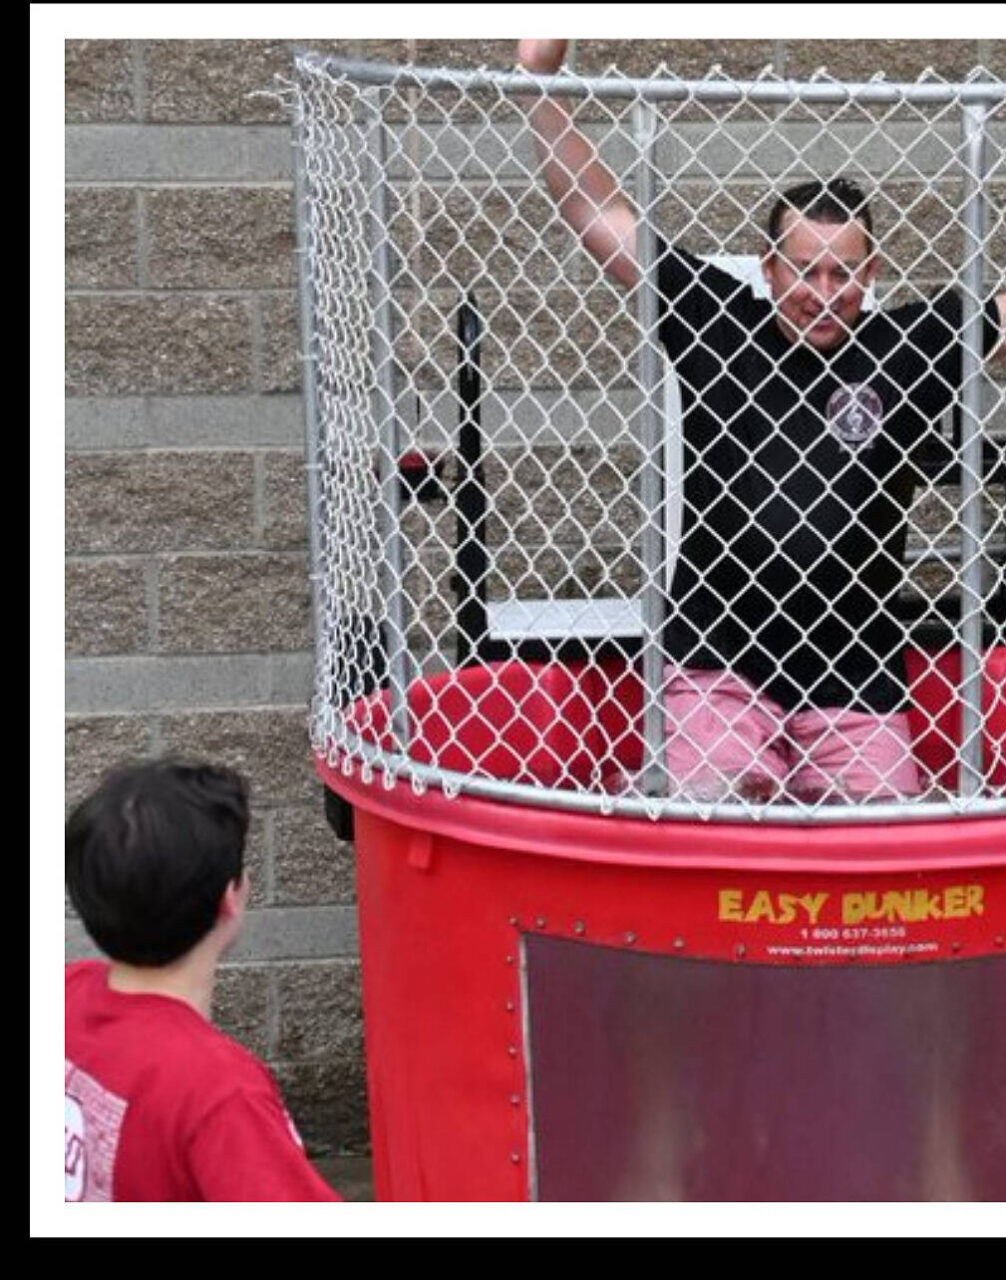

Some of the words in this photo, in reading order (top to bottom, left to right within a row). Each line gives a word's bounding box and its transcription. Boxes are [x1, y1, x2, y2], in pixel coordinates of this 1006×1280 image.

[718, 888, 829, 924] EASY
[842, 884, 984, 924] DUNKER
[801, 928, 808, 939] 1
[766, 942, 939, 958] www.twisterdisplay.com
